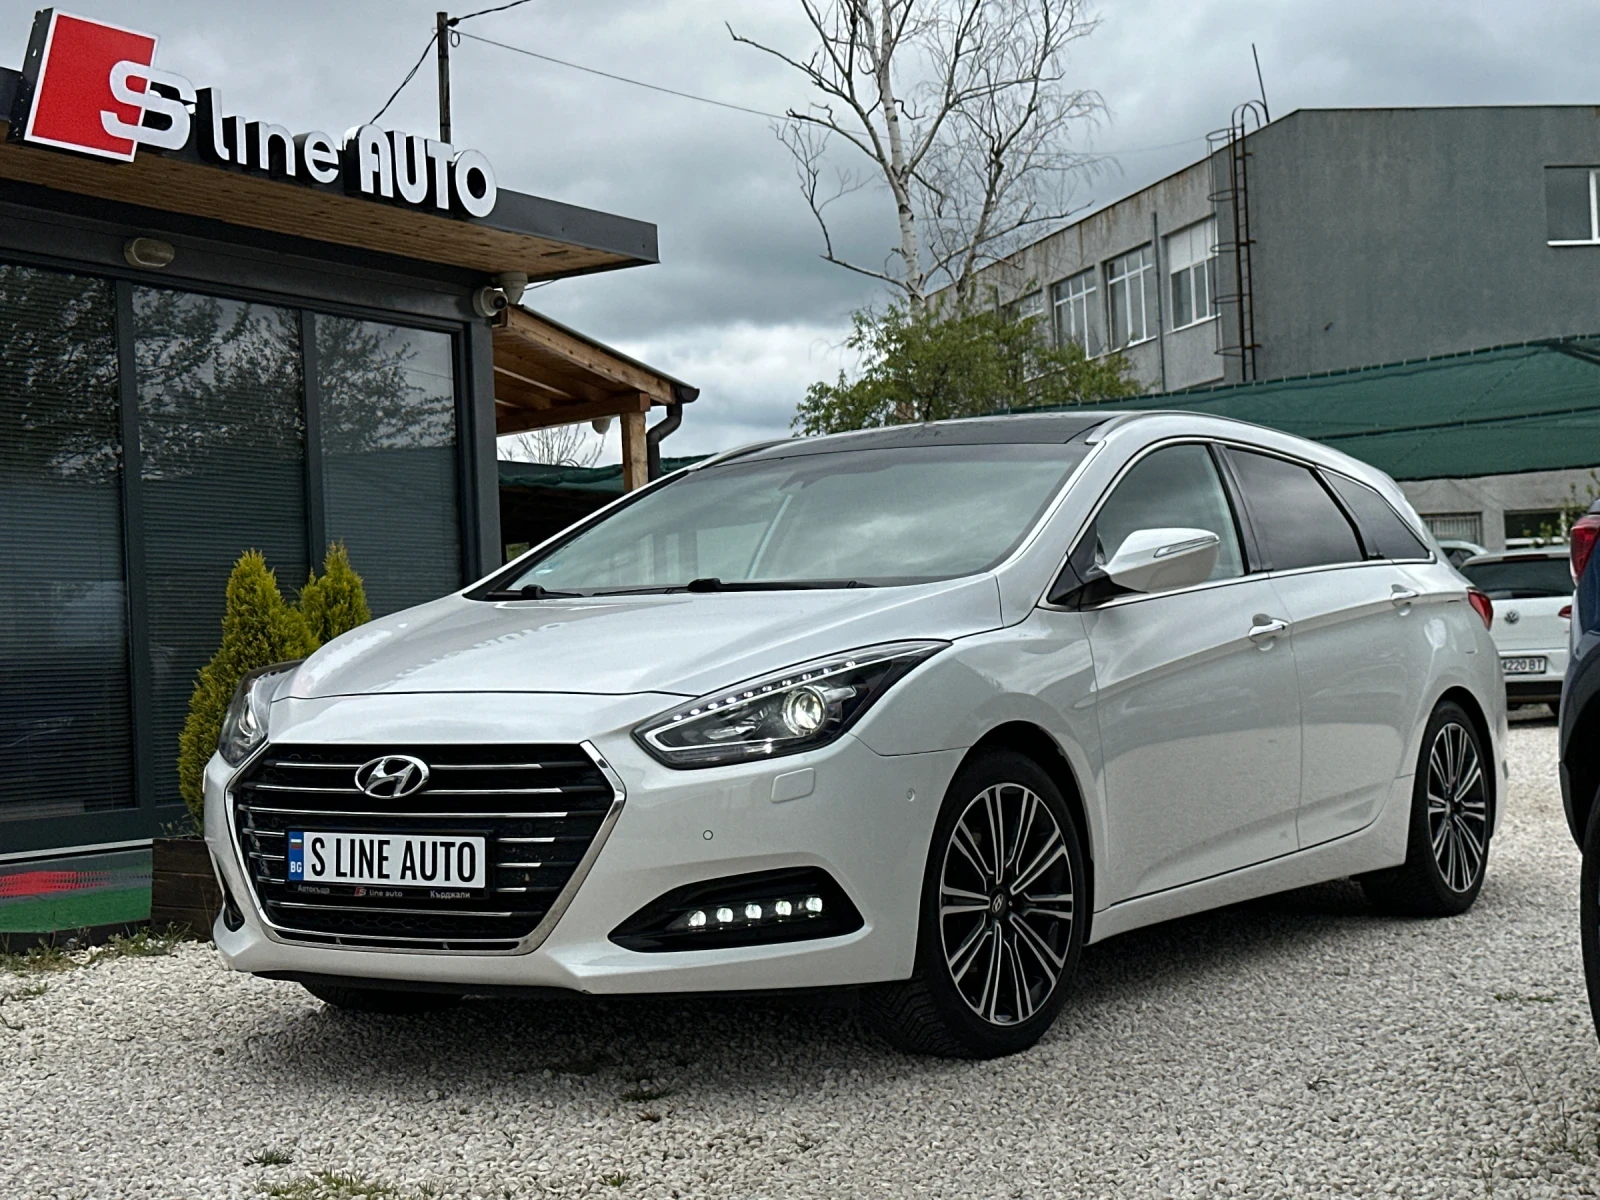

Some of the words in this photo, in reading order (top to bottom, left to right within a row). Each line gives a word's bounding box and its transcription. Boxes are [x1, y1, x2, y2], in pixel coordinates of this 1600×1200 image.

[100, 60, 198, 151] S
[207, 87, 341, 184] line
[358, 123, 498, 218] AUTO
[290, 861, 302, 873] BG
[311, 837, 326, 877] S
[335, 838, 390, 879] LINE
[400, 840, 476, 883] AUTO
[430, 890, 471, 899] Кърджали
